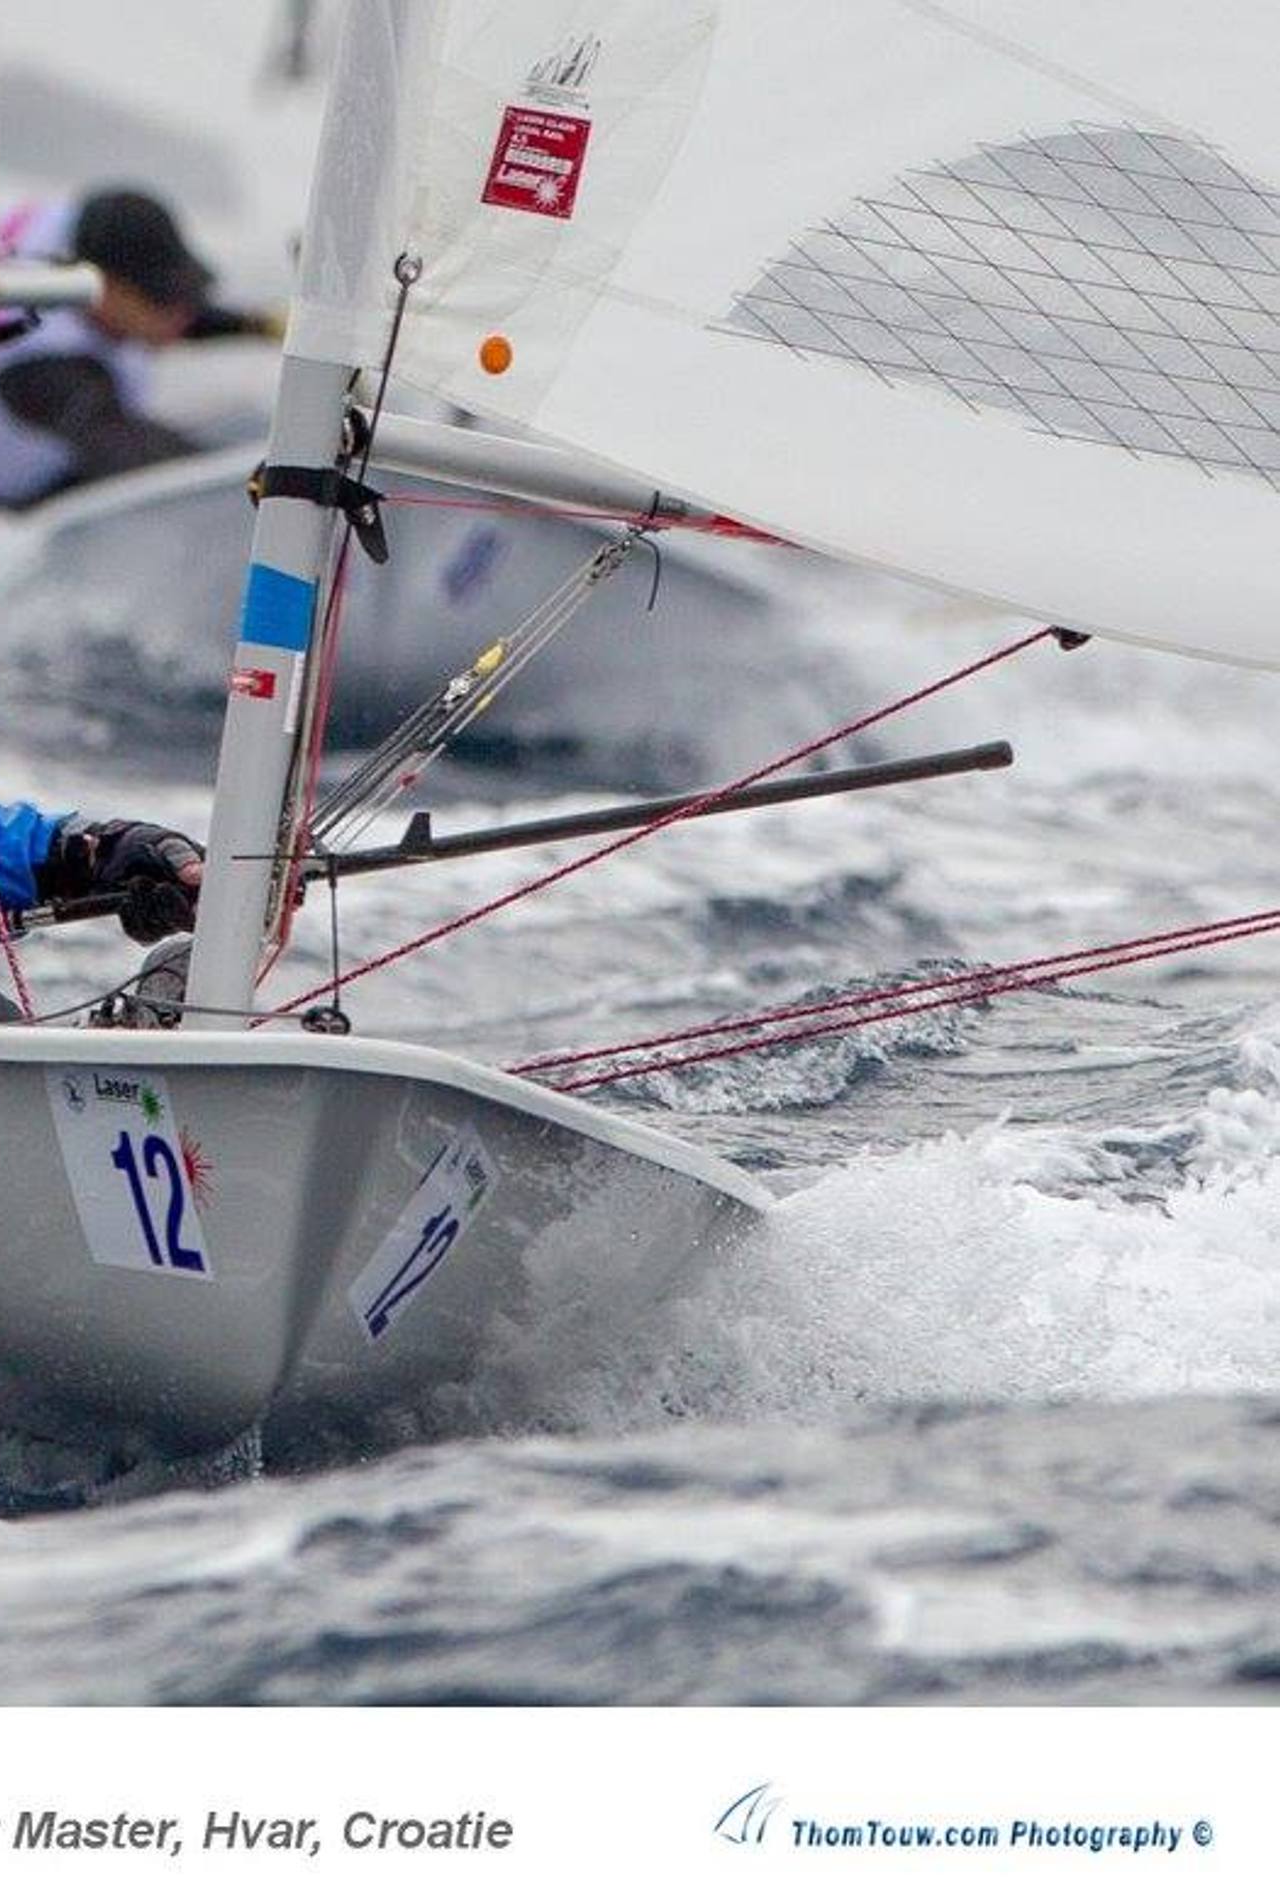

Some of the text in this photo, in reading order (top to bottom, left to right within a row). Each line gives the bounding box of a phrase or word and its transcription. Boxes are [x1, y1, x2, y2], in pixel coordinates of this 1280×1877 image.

[93, 1073, 139, 1099] Laser
[111, 1131, 205, 1272] 12
[365, 1205, 459, 1338] 12
